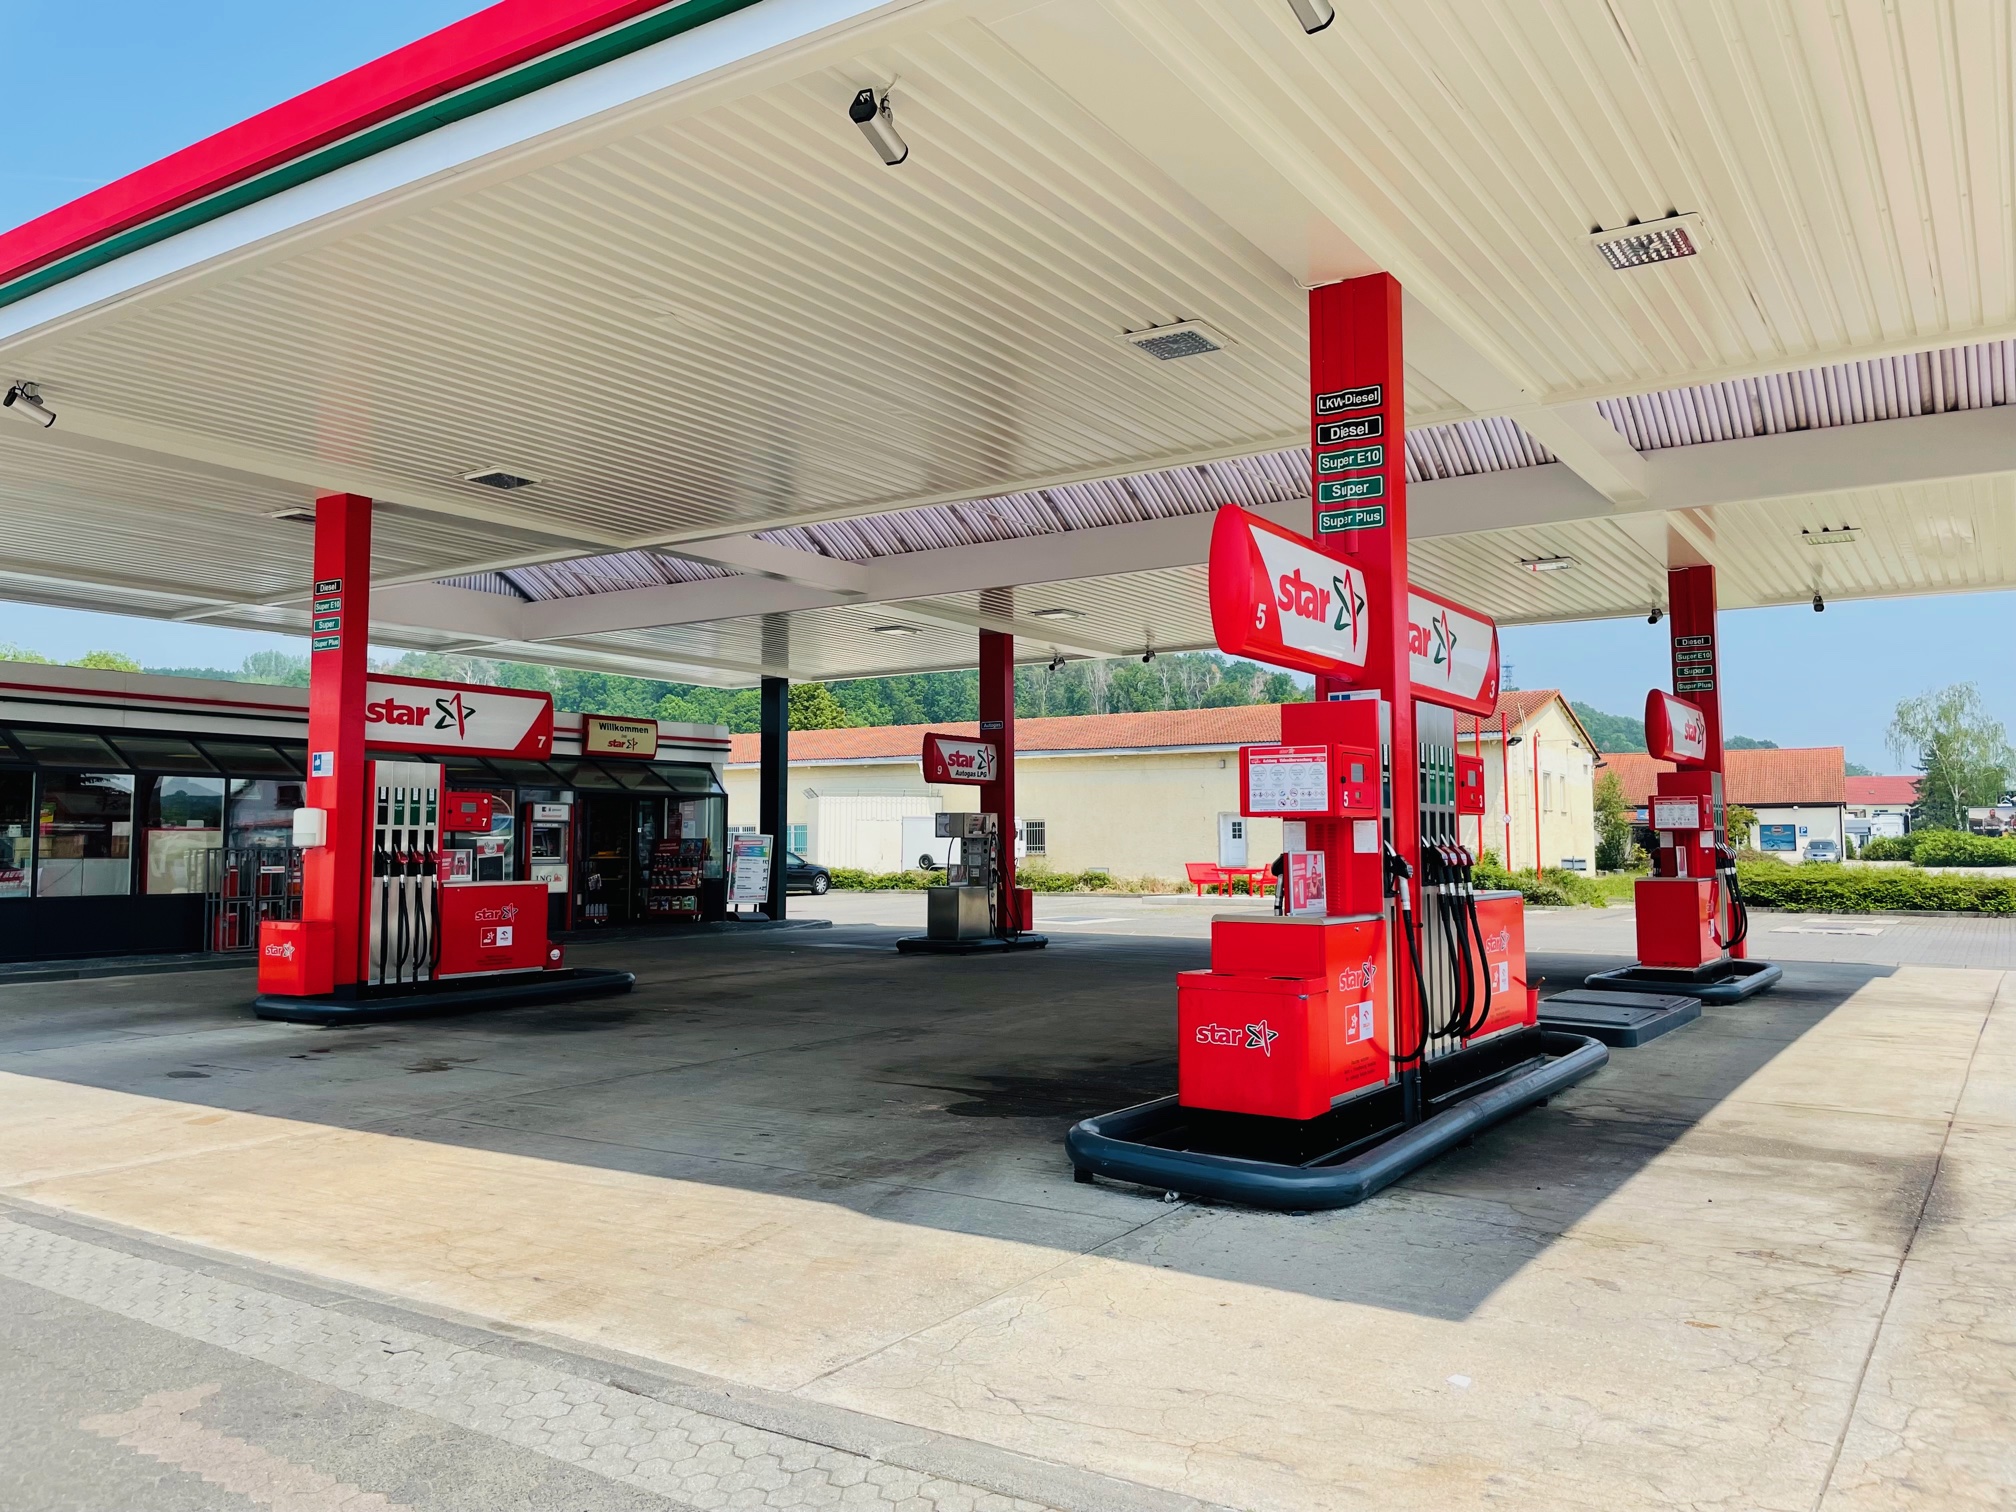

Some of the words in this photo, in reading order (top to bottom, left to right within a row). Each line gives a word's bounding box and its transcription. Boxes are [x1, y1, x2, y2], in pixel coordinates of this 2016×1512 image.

[1320, 390, 1378, 410] LKW-Diesel
[1330, 422, 1369, 440] Diesel
[1322, 455, 1354, 470] Super
[1357, 450, 1380, 464] E10
[1332, 482, 1369, 498] Super
[1356, 510, 1380, 523] Plus
[320, 582, 337, 592] Diesel
[1278, 568, 1330, 623] star
[316, 603, 329, 612] Super
[330, 601, 340, 609] E10
[1256, 602, 1266, 630] 5
[319, 621, 335, 630] Super
[315, 641, 328, 649] Super
[1489, 679, 1497, 699] 3
[365, 697, 430, 726] star
[599, 722, 649, 734] Willkommen
[1685, 719, 1697, 742] star
[537, 736, 547, 748] 7
[607, 739, 626, 748] star
[948, 750, 975, 768] star
[937, 765, 942, 775] 9
[955, 769, 976, 779] Autogas
[1343, 791, 1349, 807] 5
[1479, 795, 1483, 808] 3
[481, 818, 488, 827] 7
[536, 874, 552, 882] ING
[475, 908, 501, 921] star
[265, 943, 283, 956] star
[1486, 934, 1501, 953] star
[1339, 967, 1361, 992] star
[1196, 1023, 1242, 1046] star
